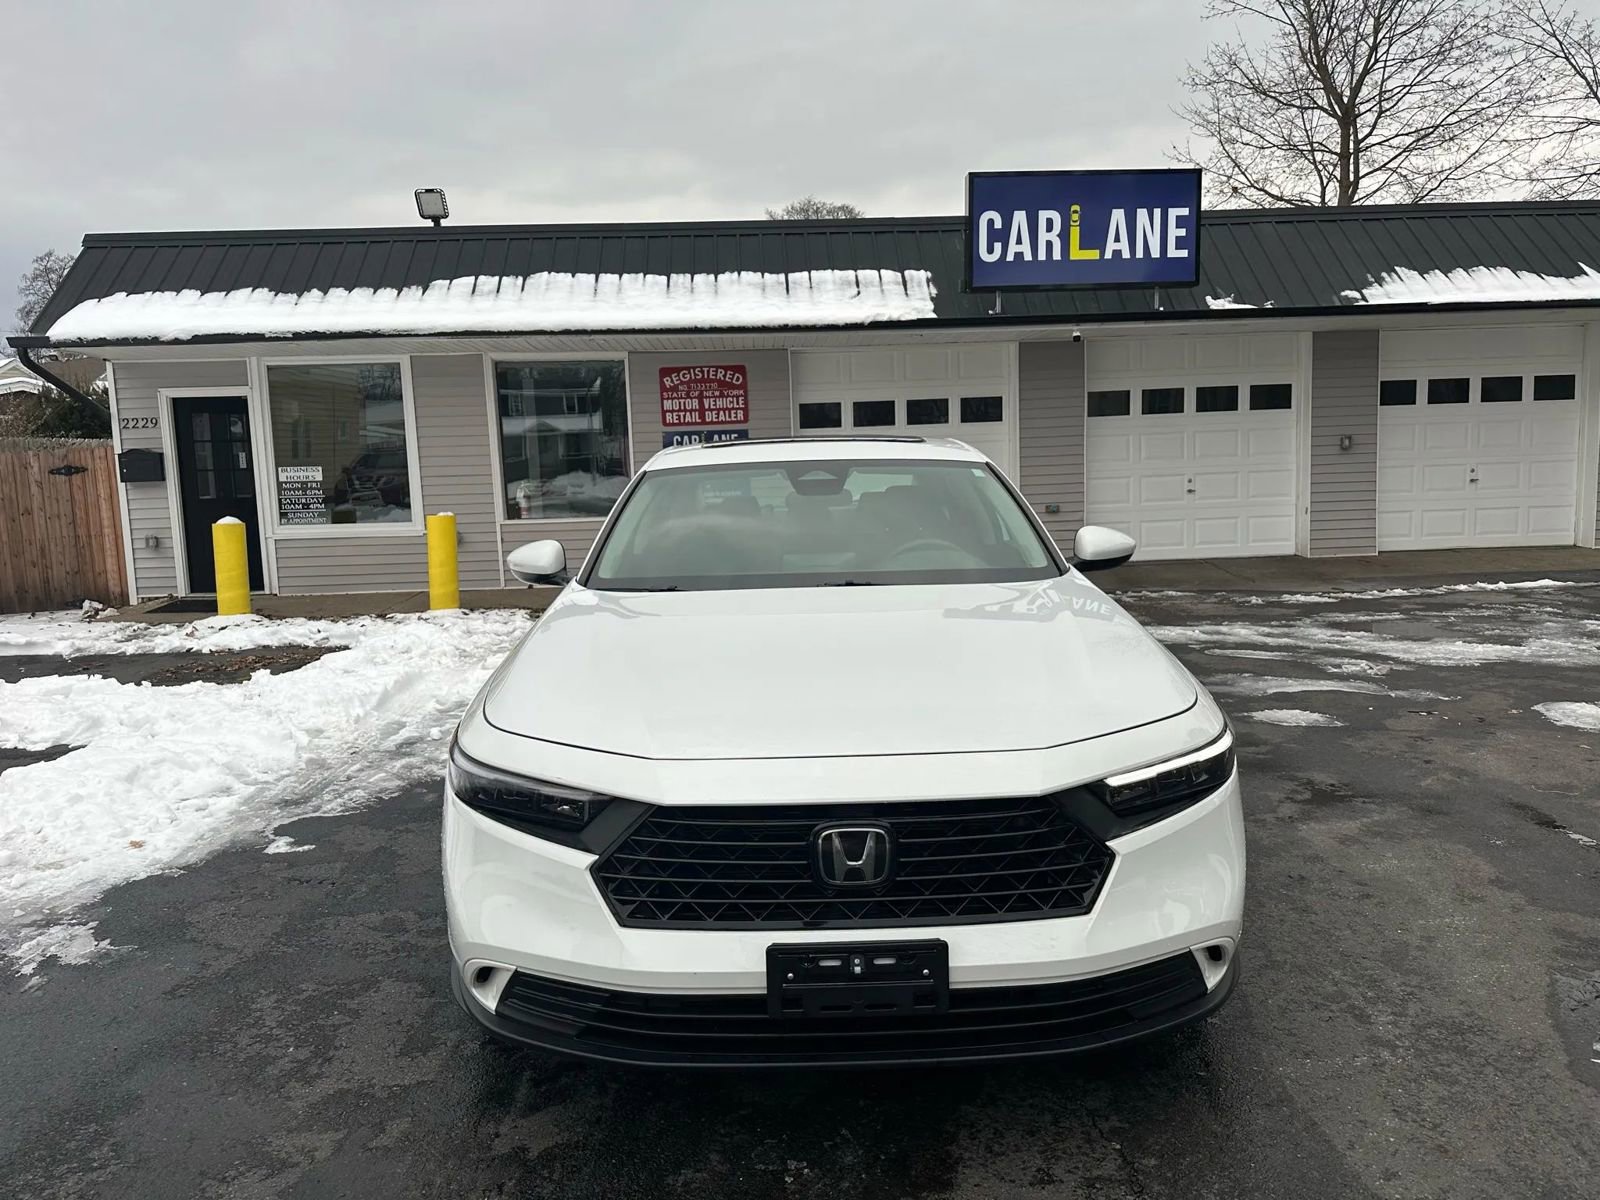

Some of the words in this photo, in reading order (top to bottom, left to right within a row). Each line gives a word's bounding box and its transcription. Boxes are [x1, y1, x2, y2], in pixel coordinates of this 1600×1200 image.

[978, 204, 1190, 263] CARLANE
[663, 367, 742, 388] REGISTERED
[663, 399, 699, 410] MOTOR
[703, 397, 745, 409] VEHICLE
[122, 417, 158, 429] 2229
[665, 412, 702, 424] RETAIL
[705, 410, 744, 422] DEALER
